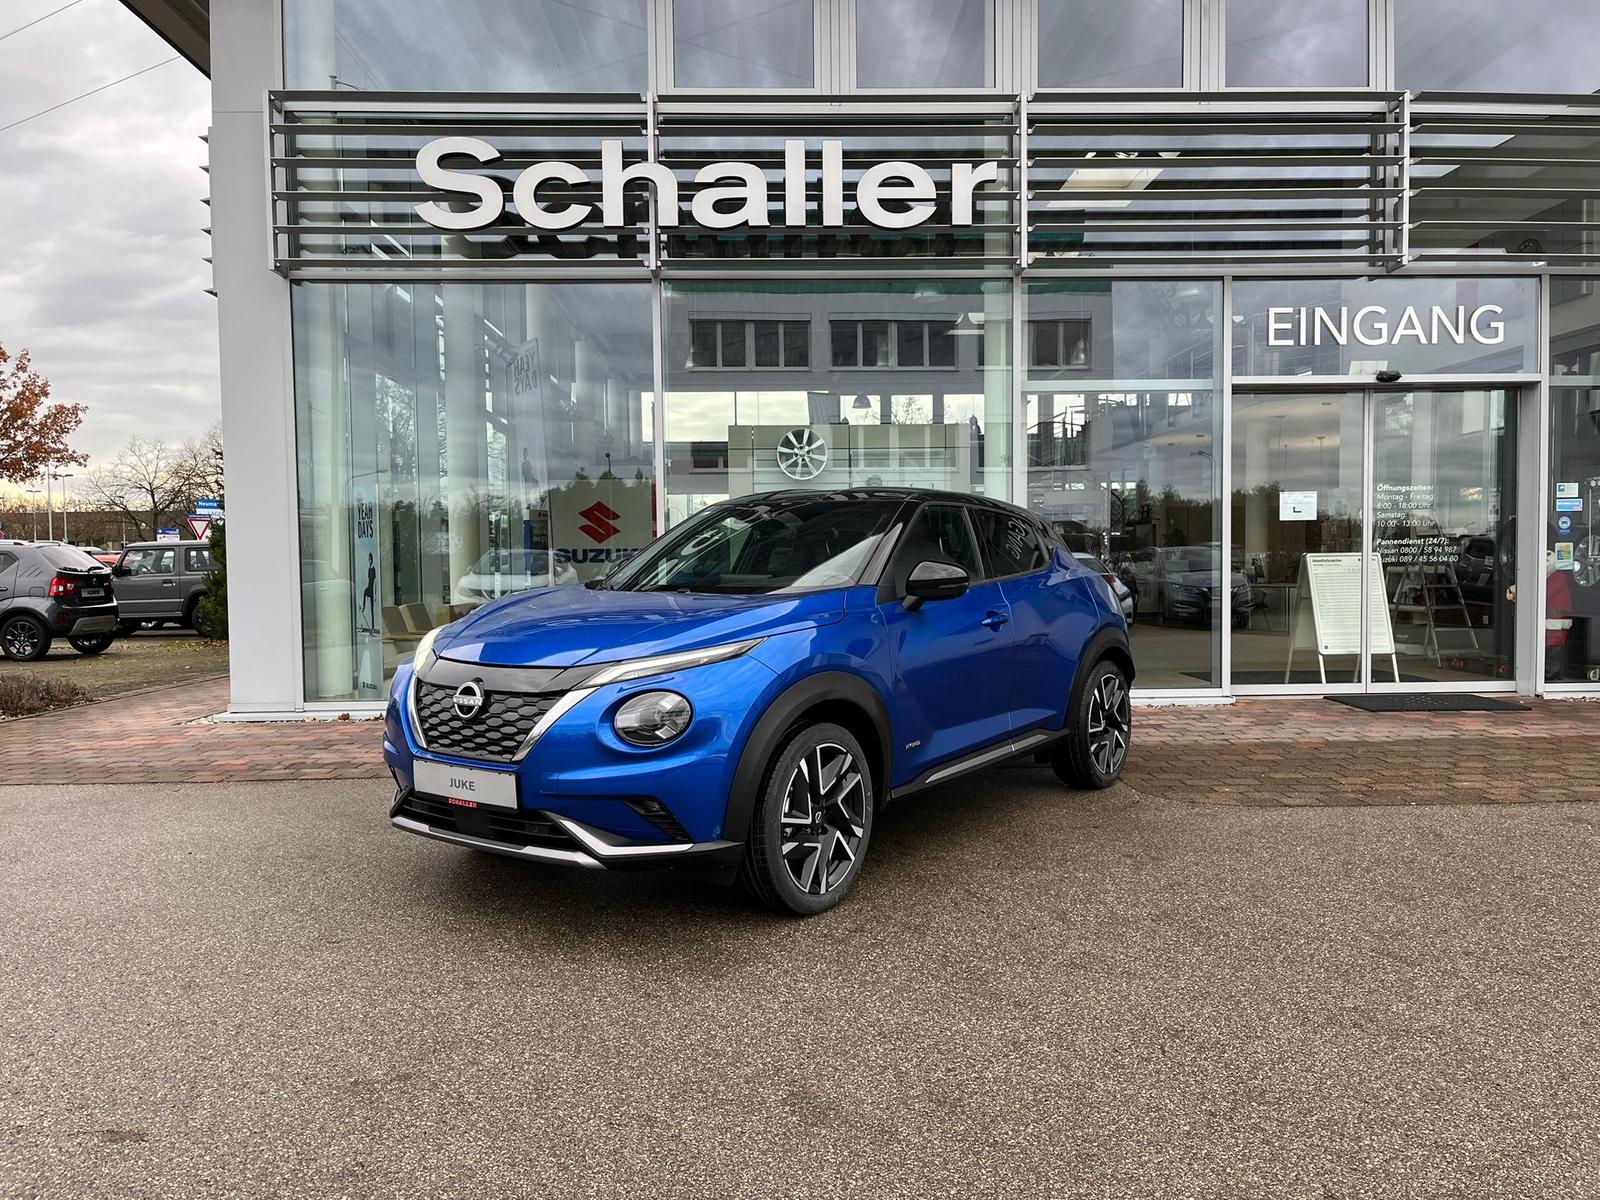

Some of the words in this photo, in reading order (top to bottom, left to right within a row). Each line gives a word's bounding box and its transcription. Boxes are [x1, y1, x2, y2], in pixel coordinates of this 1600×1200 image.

[414, 136, 998, 230] Schaller
[1268, 304, 1505, 346] EINGANG
[357, 502, 373, 520] YEAH
[357, 520, 374, 539] DAYS
[449, 777, 476, 791] JUKE
